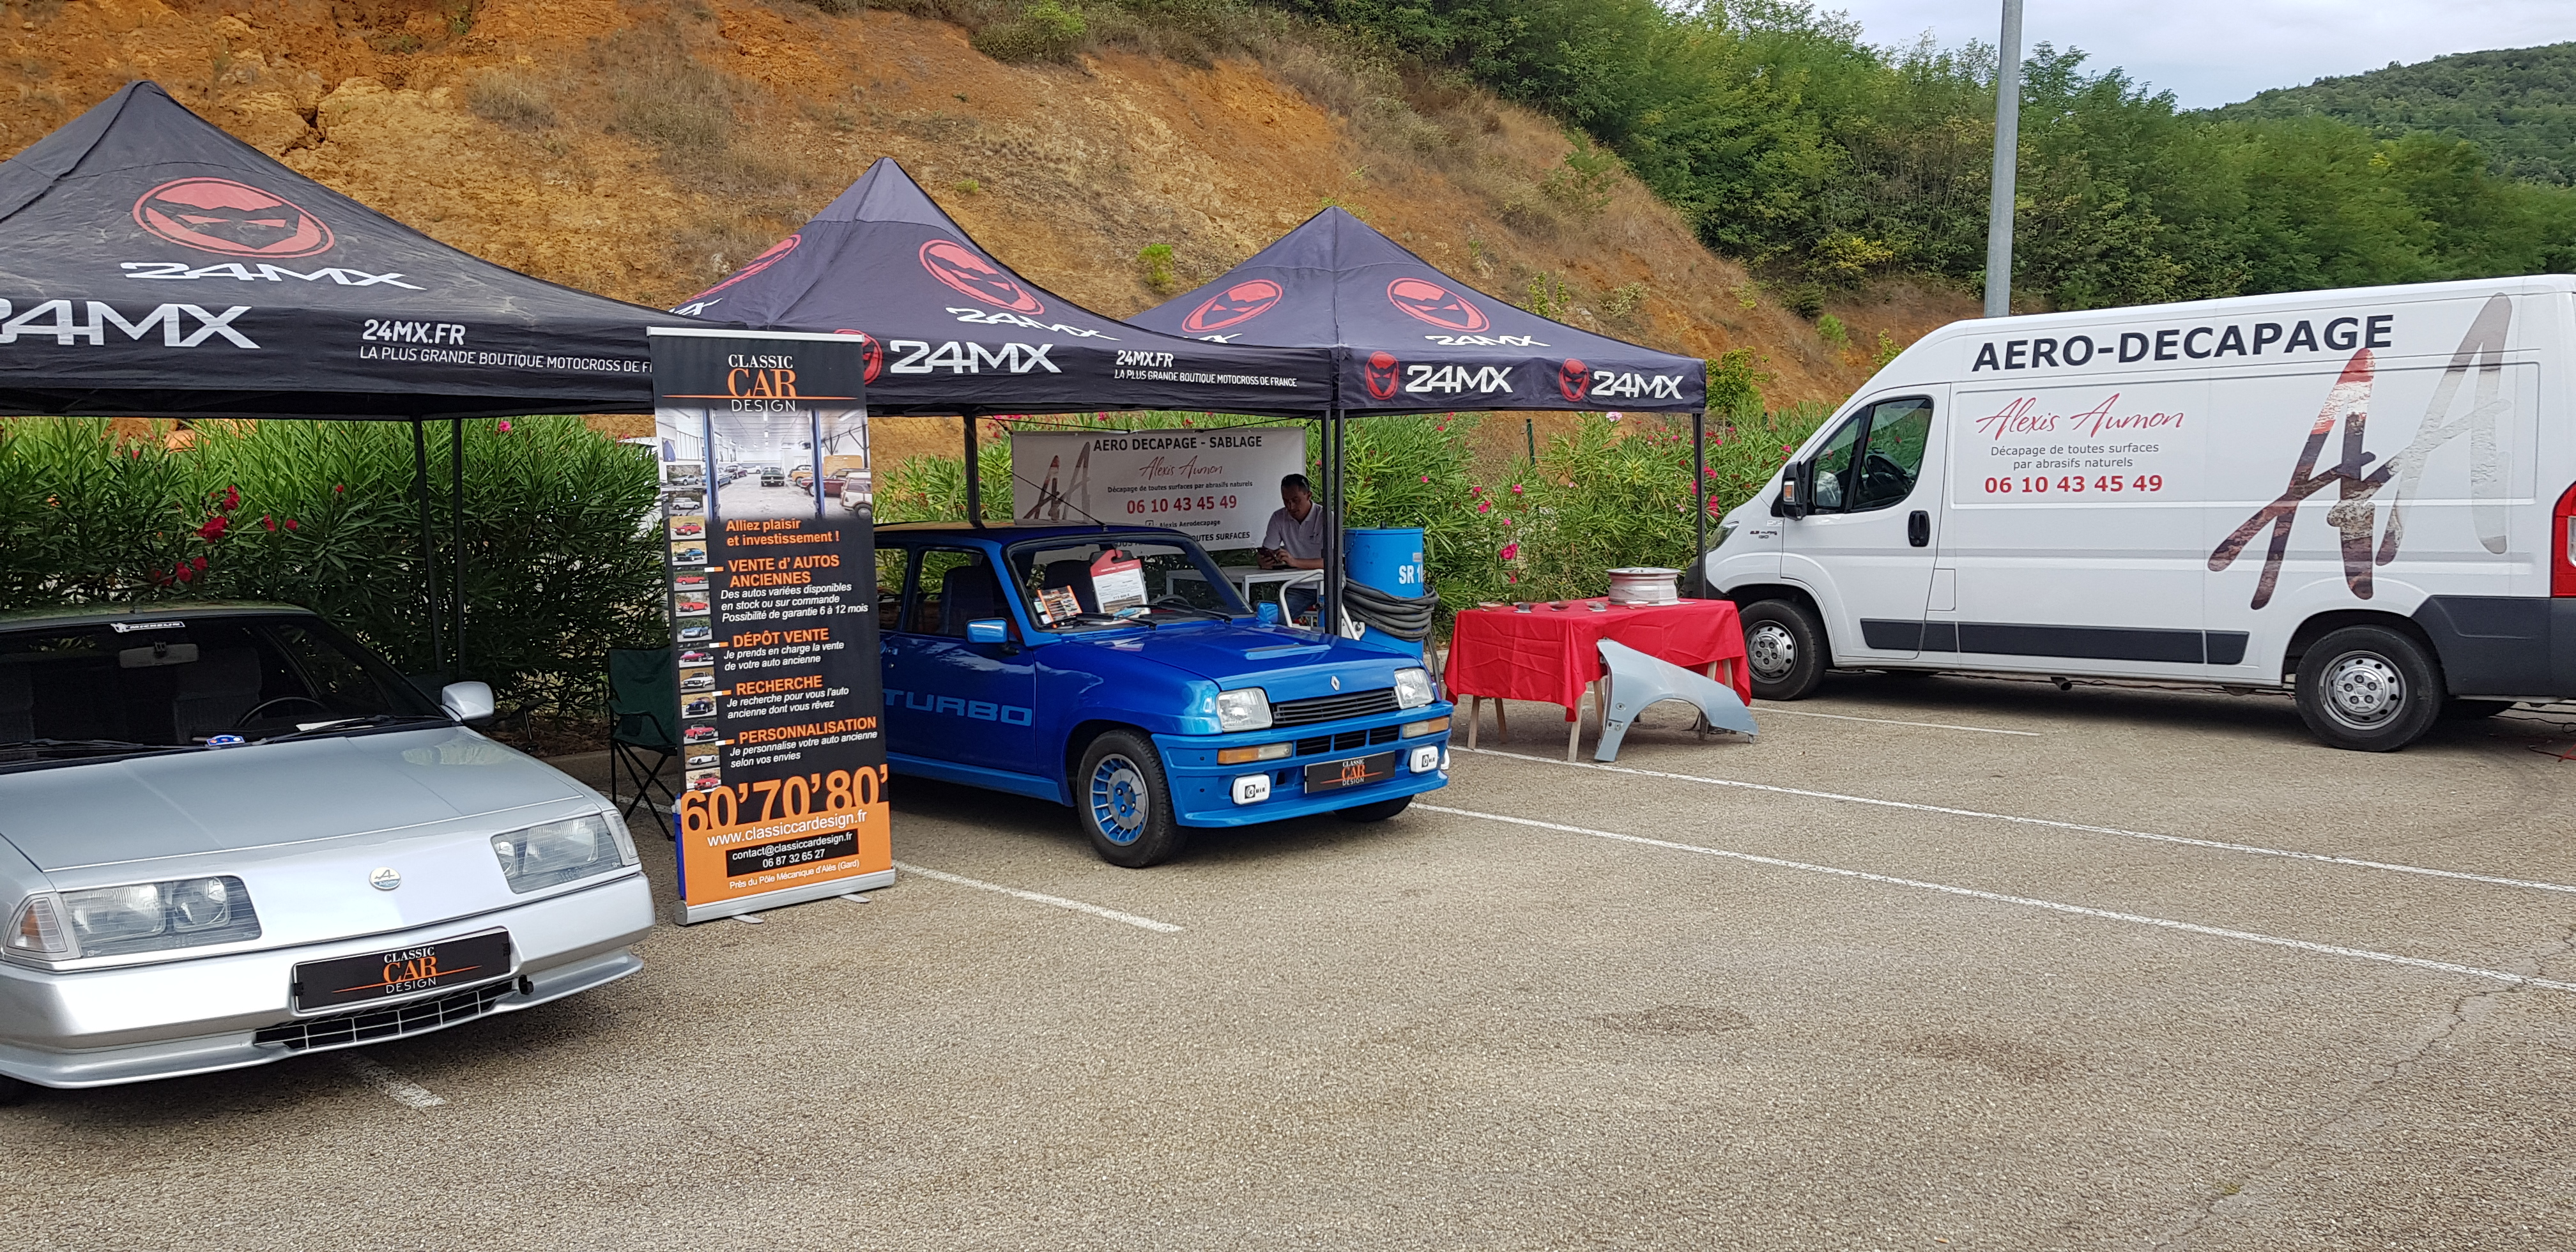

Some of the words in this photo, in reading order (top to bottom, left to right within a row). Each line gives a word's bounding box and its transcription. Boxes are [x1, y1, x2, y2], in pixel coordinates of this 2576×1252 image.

[120, 262, 427, 290] 24MX
[0, 298, 261, 349] 4MX
[362, 319, 466, 345] 24MX.FR
[946, 307, 1121, 341] 24MX
[1425, 335, 1551, 346] 24MX
[1972, 314, 2395, 372] AERO-DECAPAGE
[360, 346, 378, 359] LA
[381, 347, 417, 361] PLUS
[420, 349, 476, 364] GRANDE
[479, 352, 544, 369] BOUTIQUE
[547, 357, 620, 372] MOTOCROSS
[624, 361, 640, 372] DE
[728, 355, 793, 369] CLASSIC
[889, 340, 1063, 373] 24MX
[1116, 350, 1174, 368] 24MX.FR
[727, 369, 797, 397] CAR
[1114, 369, 1125, 379] LA
[1126, 370, 1146, 379] PLUS
[1149, 371, 1178, 381] GRANDE
[1180, 372, 1215, 384] BOUTIQUE
[1218, 374, 1259, 385] MOTOCROSS
[1260, 377, 1269, 385] DE
[1271, 378, 1297, 387] FRANCE
[1406, 365, 1514, 393] 24MX
[1591, 371, 1683, 400] 24MX
[732, 399, 796, 412] DESIGN
[1975, 397, 2060, 441] Alexis
[2070, 393, 2184, 438] Aumon
[1094, 438, 1127, 452] AERO
[1133, 436, 1197, 450] DECAPAGE
[1209, 436, 1262, 447] SABLAGE
[1991, 446, 2046, 456] Décapage
[2050, 446, 2064, 455] de
[2067, 446, 2104, 454] toutes
[2108, 443, 2159, 453] surfaces
[1139, 456, 1176, 480] Alexis
[2012, 460, 2033, 471] par
[2035, 459, 2081, 469] abrasifs
[2084, 457, 2134, 468] naturels
[1108, 484, 1138, 493] Décapage
[1984, 478, 2012, 493] 06
[2021, 477, 2048, 492] 10
[2057, 477, 2086, 492] 43
[2094, 476, 2124, 491] 45
[2132, 475, 2163, 491] 49
[1127, 500, 1146, 514] 06
[1151, 499, 1168, 512] 10
[1174, 498, 1191, 511] 43
[1197, 496, 1215, 510] 45
[1220, 495, 1237, 509] 49
[726, 520, 760, 532] Alliez
[763, 518, 802, 533] plaisir
[1179, 519, 1221, 529] Aerodecapage
[727, 536, 740, 546] et
[742, 532, 832, 546] investissement
[1216, 531, 1250, 541] SURFACES
[728, 558, 775, 572] VENTE
[794, 554, 840, 568] AUTOS
[730, 572, 811, 588] ANCIENNES
[1399, 565, 1414, 584] SR
[721, 590, 740, 599] Des
[742, 588, 767, 598] autos
[769, 585, 802, 596] variées
[804, 583, 852, 597] disponibles
[721, 602, 733, 611] en
[736, 599, 760, 610] stock
[775, 599, 790, 607] sur
[792, 595, 840, 606] commande
[722, 610, 767, 622] Possibilité
[768, 609, 780, 619] de
[783, 606, 818, 620] garantie
[820, 606, 825, 615] 6
[827, 605, 833, 614] à
[836, 605, 845, 614] 12
[848, 603, 868, 613] mois
[733, 629, 780, 648] DÉPÔT
[783, 628, 829, 643] VENTE
[724, 650, 735, 660] Je
[737, 648, 766, 660] prends
[769, 647, 779, 655] en
[781, 643, 811, 657] charge
[813, 643, 820, 652] la
[822, 641, 845, 650] vente
[724, 661, 736, 671] de
[738, 660, 760, 669] votre
[762, 658, 780, 668] auto
[783, 654, 821, 666] ancienne
[736, 675, 823, 696] RECHERCHE
[727, 698, 737, 708] Je
[740, 693, 782, 705] recherche
[784, 692, 804, 703] pour
[806, 691, 826, 699] vous
[828, 687, 849, 697] l'auto
[728, 706, 767, 719] ancienne
[769, 704, 788, 714] dont
[790, 703, 809, 712] vous
[812, 699, 834, 710] rêvez
[882, 689, 1032, 727] TURBO
[739, 716, 877, 745] PERSONNALISATION
[730, 747, 741, 757] Je
[743, 741, 797, 756] personnalise
[799, 738, 820, 747] votre
[822, 736, 839, 745] auto
[841, 731, 878, 742] ancienne
[731, 758, 755, 768] selon
[756, 756, 771, 764] vos
[773, 752, 801, 763] envies
[1342, 759, 1365, 767] CLASSIC
[1342, 765, 1366, 779] CAR
[1342, 777, 1365, 786] DESIGN
[707, 809, 868, 847] www.classiccardesign.fr
[732, 832, 853, 860] contact@classiccardesign.fr
[763, 858, 774, 868] 06
[776, 856, 786, 866] 87
[789, 854, 800, 864] 32
[802, 851, 813, 862] 65
[815, 849, 825, 859] 27
[730, 880, 746, 890] Près
[749, 877, 758, 886] du
[759, 874, 775, 884] Pôle
[777, 867, 815, 882] Mécanique
[816, 864, 836, 874] d'Alès
[838, 859, 860, 871] (Gard)
[384, 947, 435, 963] CLASSIC
[383, 956, 438, 984] CAR
[386, 977, 437, 994] DESIGN
